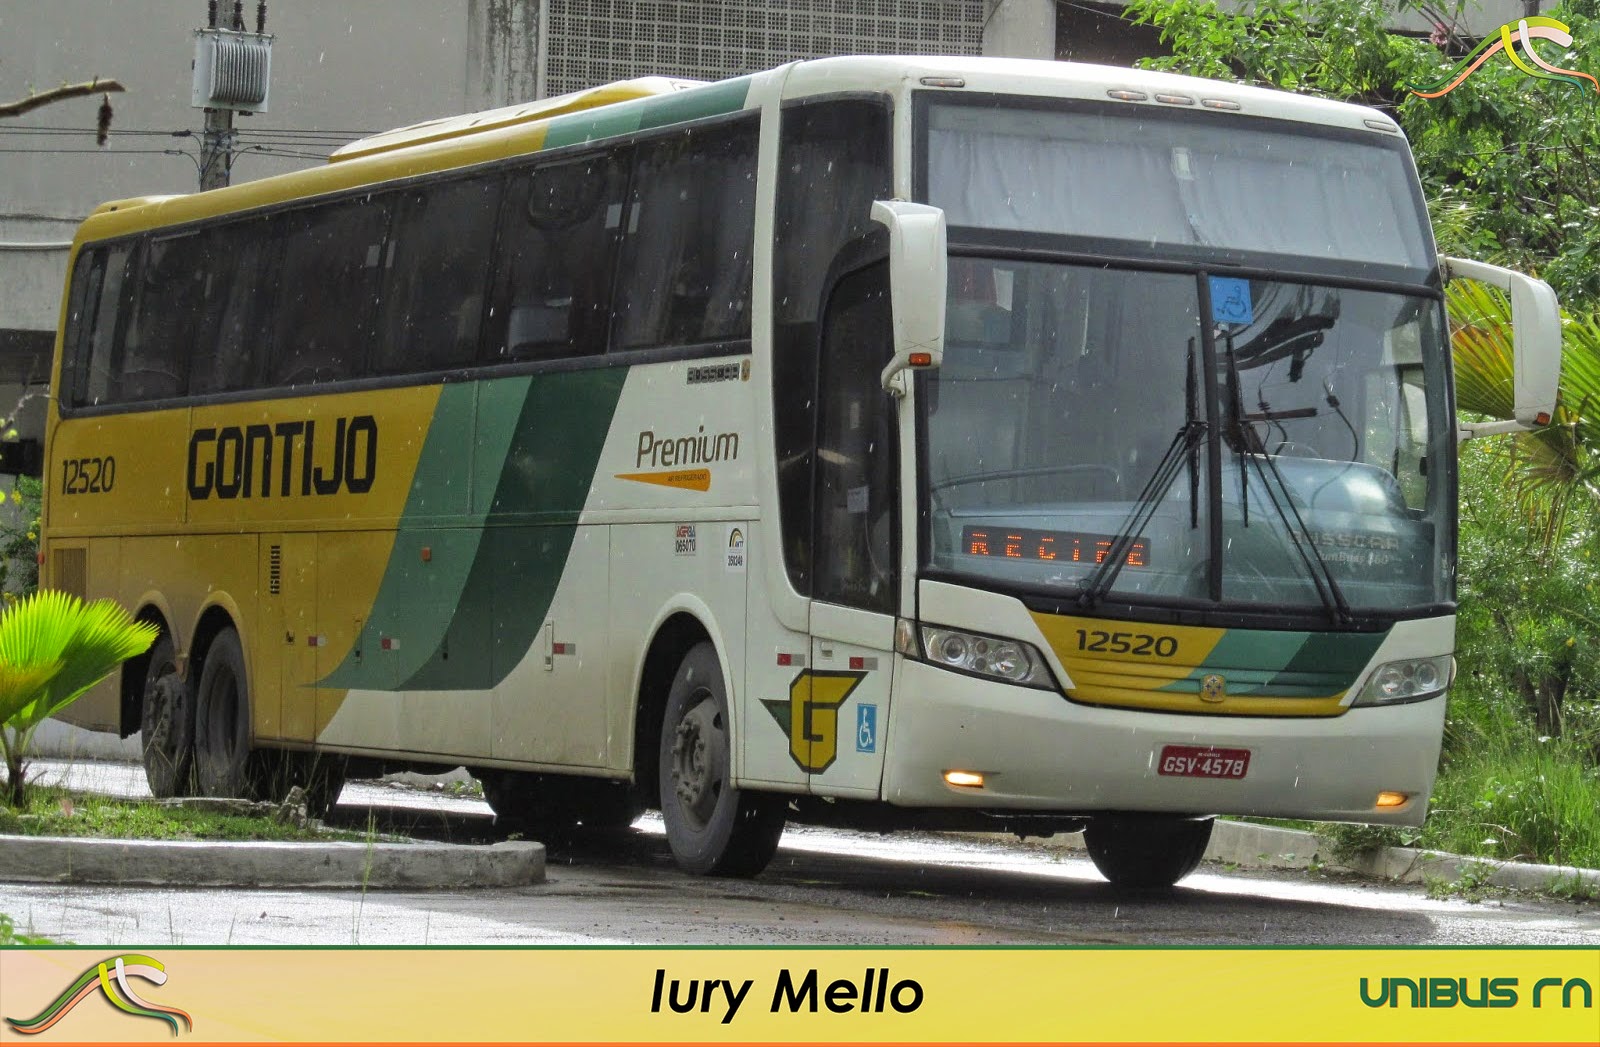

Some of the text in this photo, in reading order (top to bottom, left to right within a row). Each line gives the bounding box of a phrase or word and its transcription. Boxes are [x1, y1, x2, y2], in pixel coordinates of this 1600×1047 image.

[187, 415, 378, 500] GONTIJO
[636, 425, 739, 468] Premium
[62, 455, 116, 495] 12520
[1076, 629, 1179, 657] 12520
